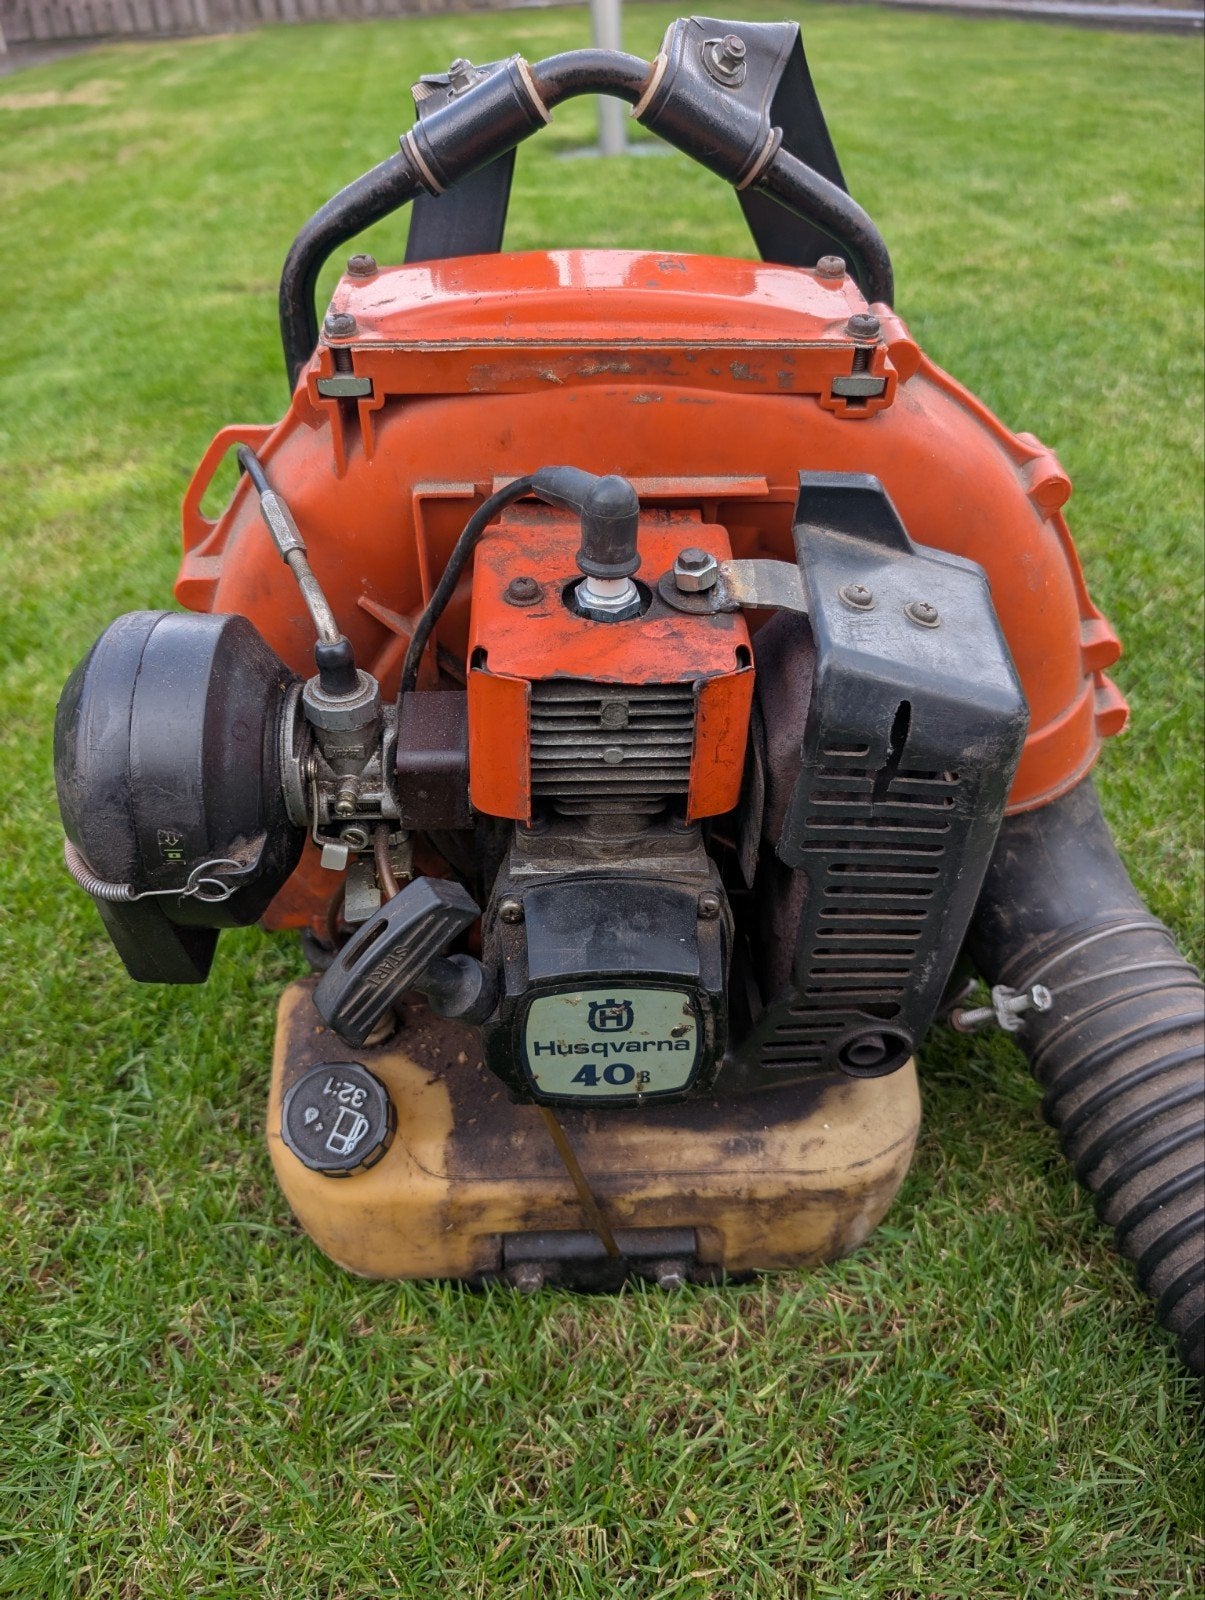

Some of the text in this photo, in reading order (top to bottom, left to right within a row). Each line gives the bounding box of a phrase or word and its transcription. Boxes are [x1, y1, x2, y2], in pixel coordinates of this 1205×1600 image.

[366, 945, 409, 989] START
[533, 1039, 690, 1057] Husqvarna
[323, 1076, 367, 1107] 32:1
